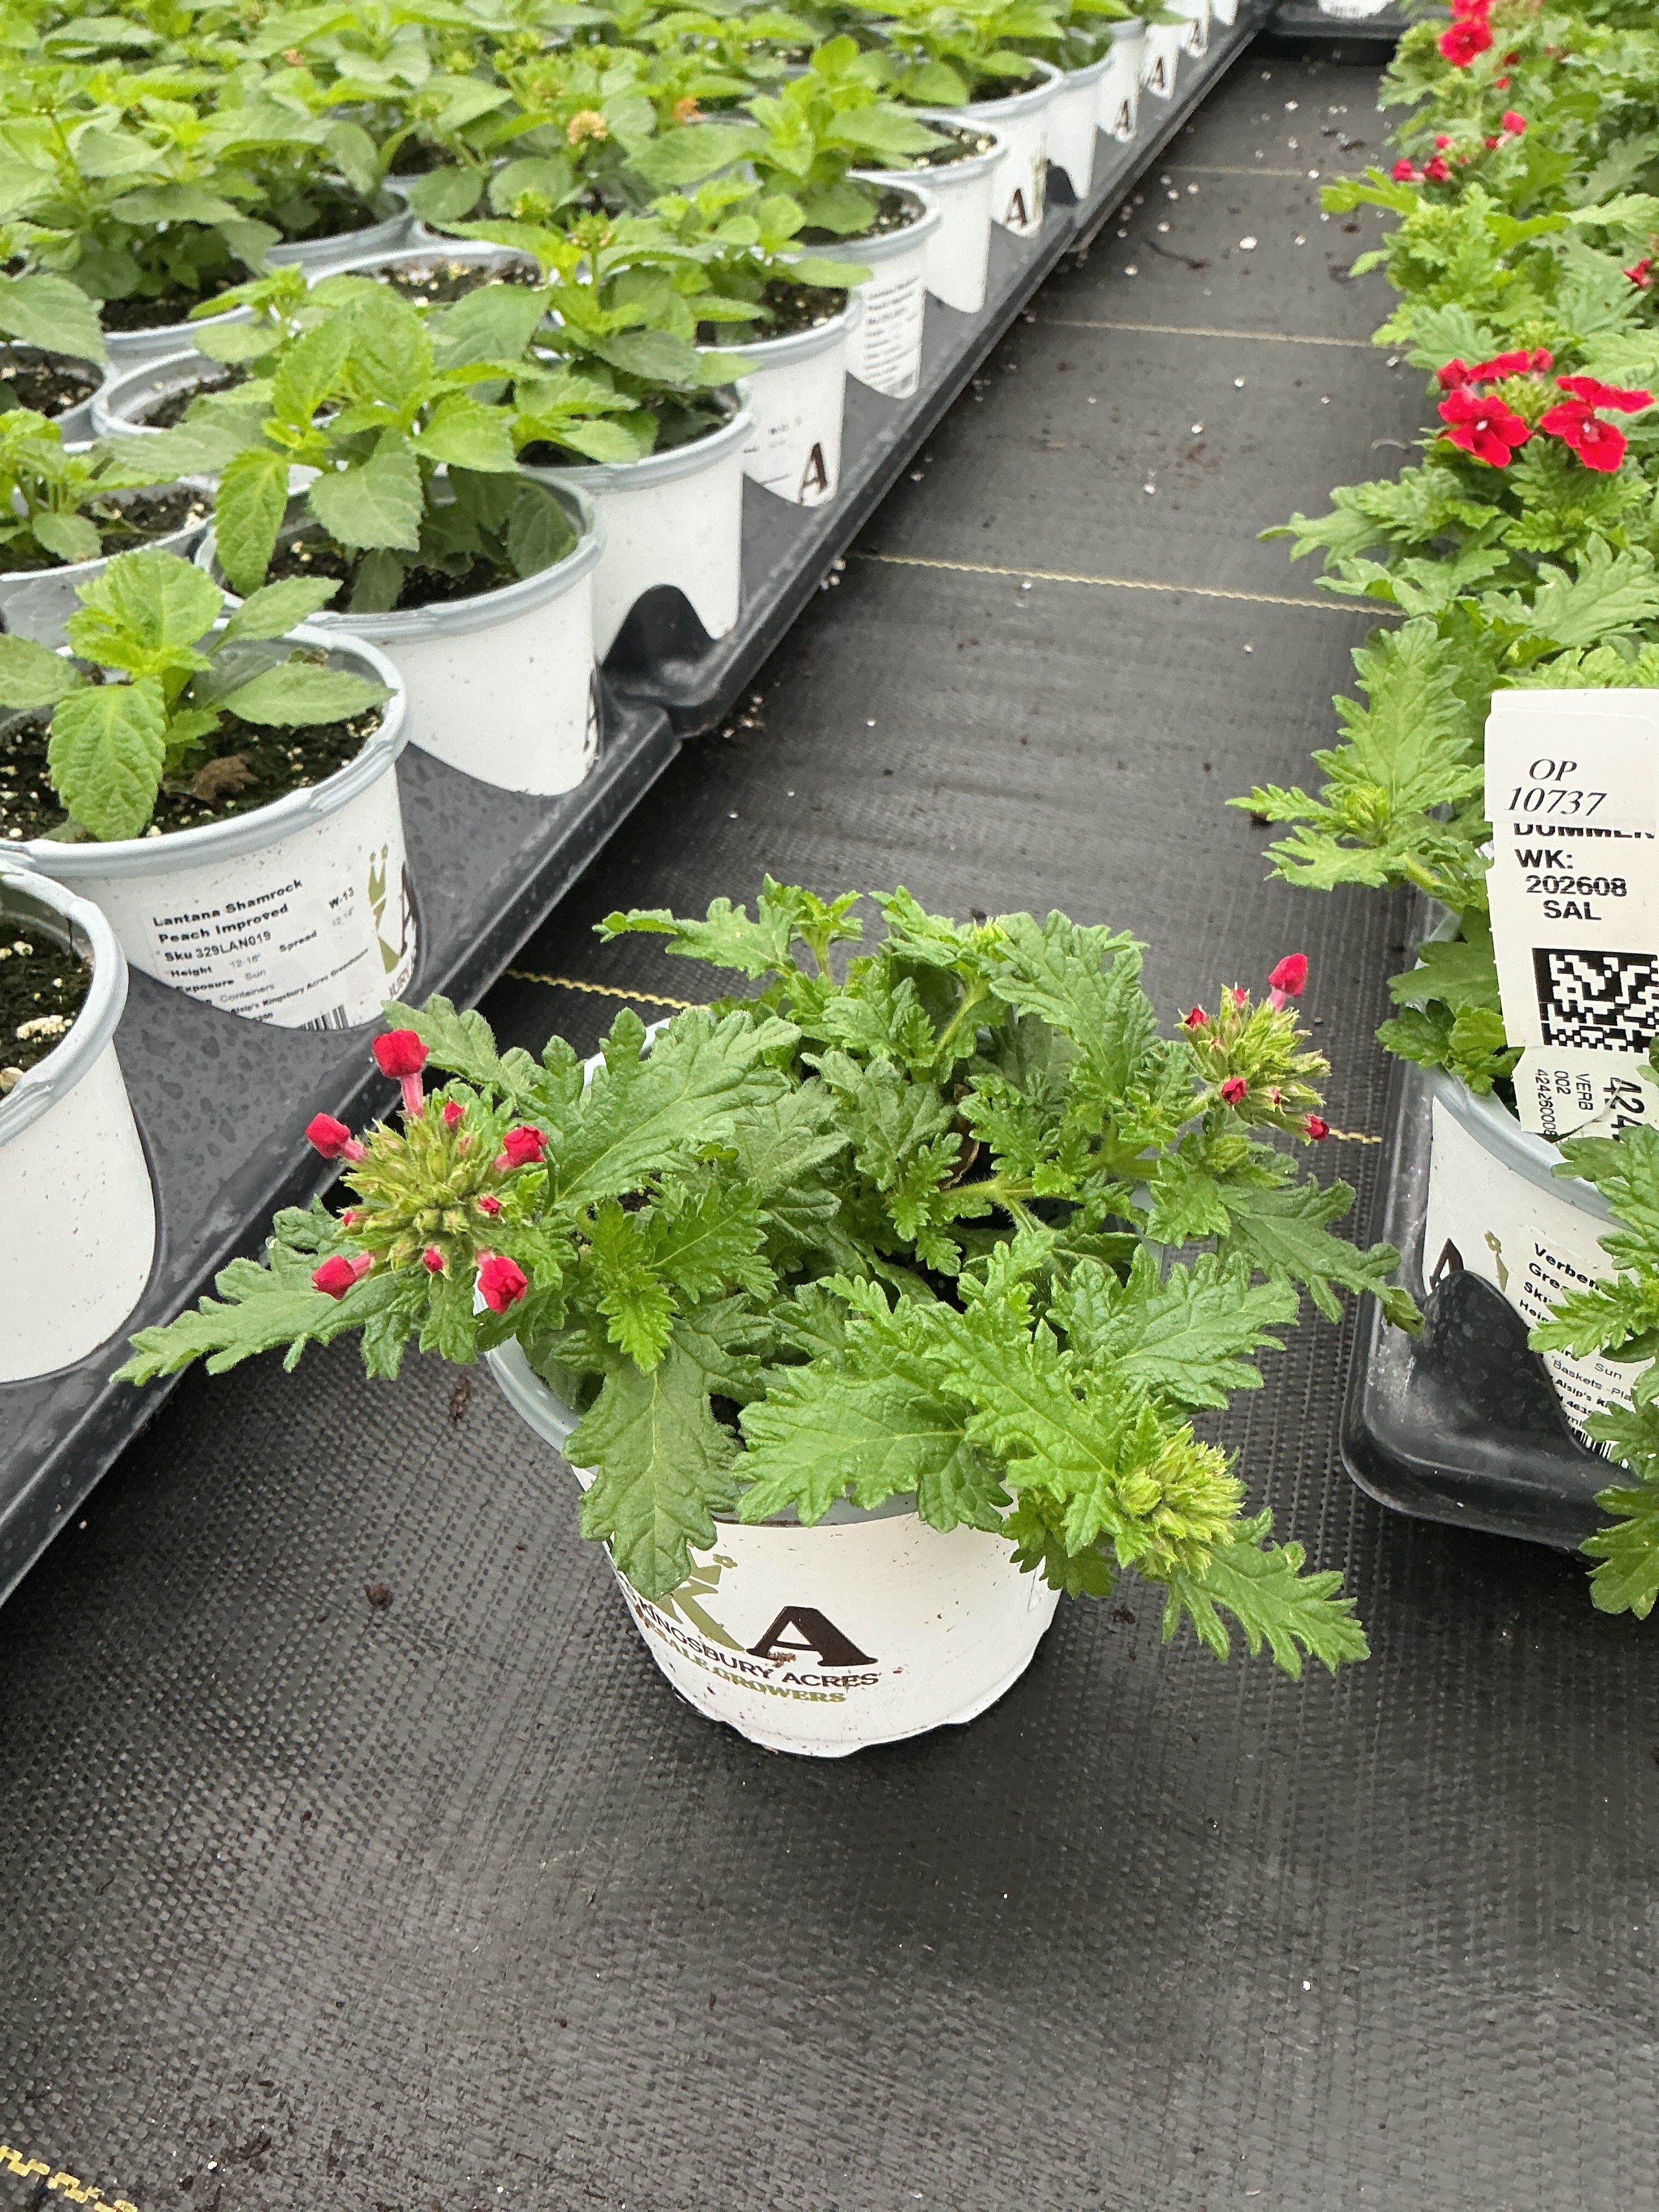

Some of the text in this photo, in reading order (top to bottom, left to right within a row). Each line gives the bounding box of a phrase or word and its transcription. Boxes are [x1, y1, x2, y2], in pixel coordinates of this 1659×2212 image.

[797, 442, 828, 504] A
[1529, 759, 1577, 782] OP
[1504, 787, 1607, 817] 10737
[1514, 849, 1573, 870] WK:
[1525, 874, 1628, 898] 202608
[153, 878, 303, 927] Lantana Shamrock
[1543, 900, 1602, 921] SAL
[159, 903, 289, 944] Peach Improved
[165, 930, 272, 962] Sku 329LAN019
[171, 966, 212, 977] Height
[279, 930, 317, 952] Spread
[1554, 1070, 1571, 1095] 002
[1576, 1073, 1594, 1111] VERB
[1529, 1262, 1569, 1290] Gre
[1534, 1243, 1600, 1291] Verben
[1520, 1299, 1549, 1322] Hei
[1553, 1359, 1603, 1390] Baskets
[1594, 1363, 1622, 1380] Sun
[1566, 1400, 1593, 1415] 463
[747, 1606, 879, 1667] A
[712, 1666, 848, 1703] GROWERS
[782, 1672, 879, 1688] ACRES
